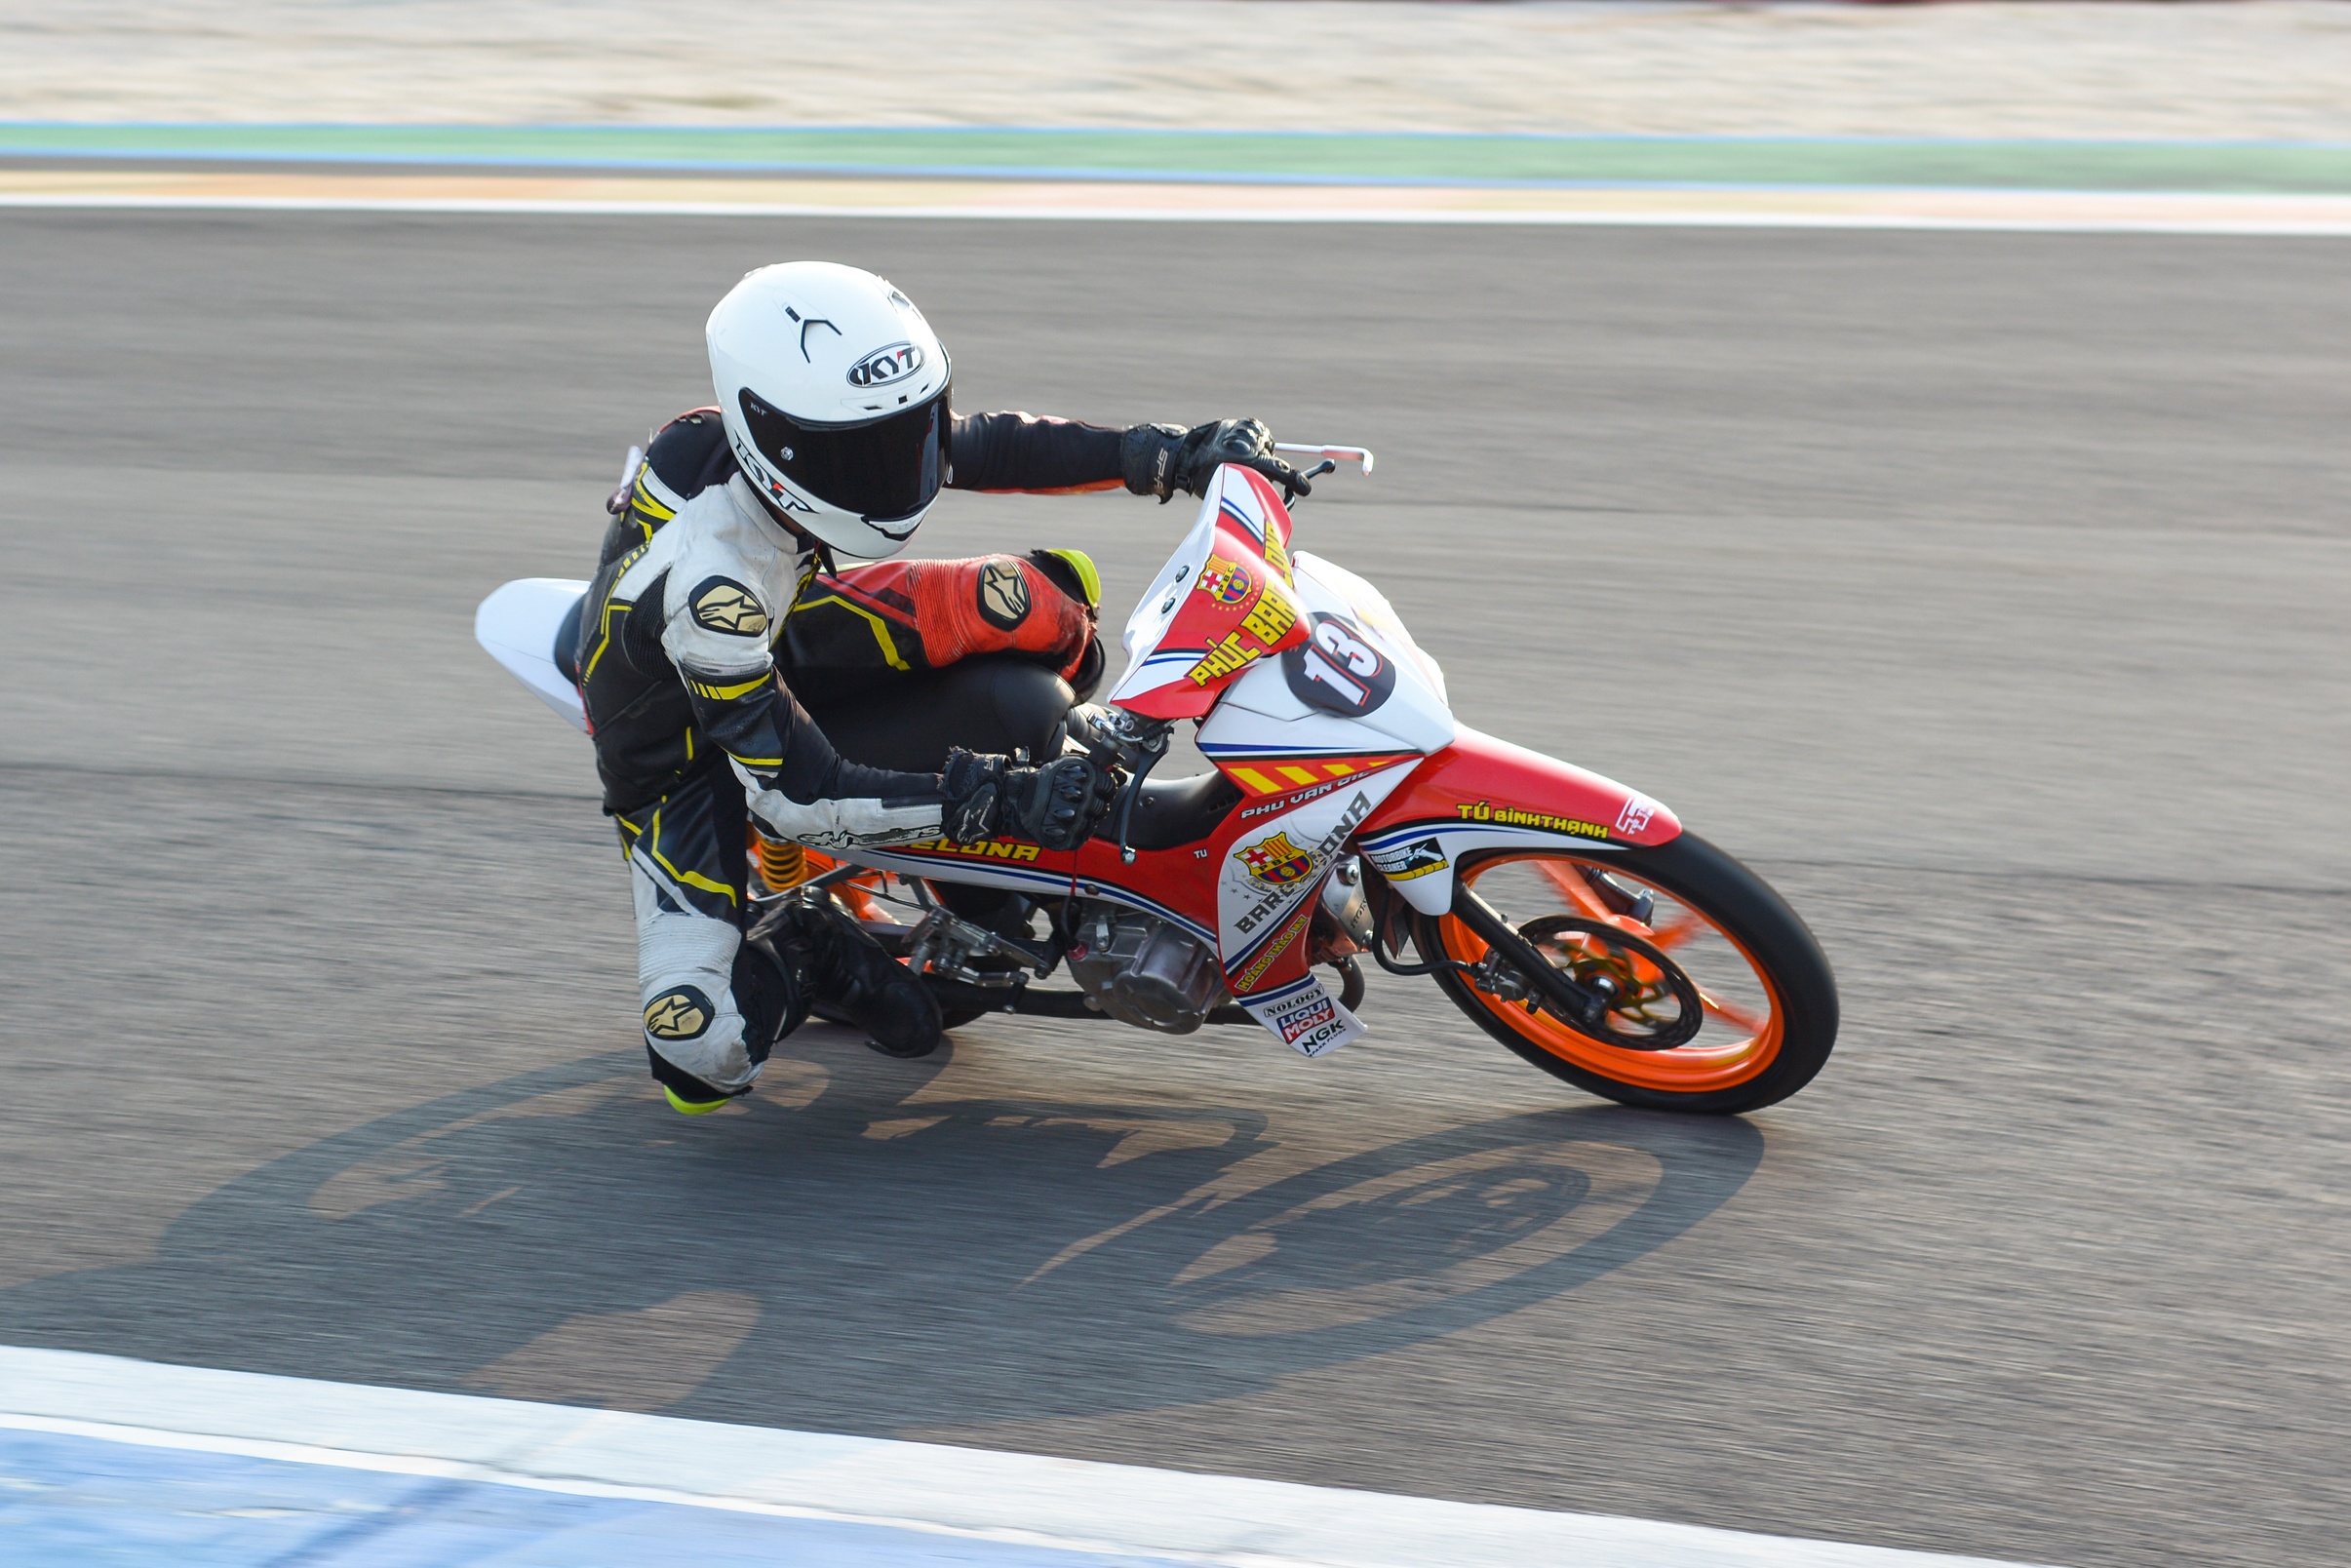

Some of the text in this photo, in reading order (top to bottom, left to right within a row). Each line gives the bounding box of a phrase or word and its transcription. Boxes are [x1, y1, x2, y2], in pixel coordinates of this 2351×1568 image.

[857, 346, 916, 385] KYT
[734, 429, 820, 511] KYT
[1304, 620, 1383, 706] 13
[1240, 799, 1285, 819] PHU
[1290, 782, 1333, 804] VAN
[1457, 801, 1490, 820] TÚ
[1193, 848, 1208, 859] TU
[1371, 845, 1413, 864] MOTORBIKE
[1376, 860, 1408, 873] CLEANER
[1266, 985, 1324, 1017] NOLOGY
[1279, 999, 1329, 1028] LIQUI
[1284, 1008, 1331, 1041] MOLY
[1302, 1018, 1345, 1054] NGK
